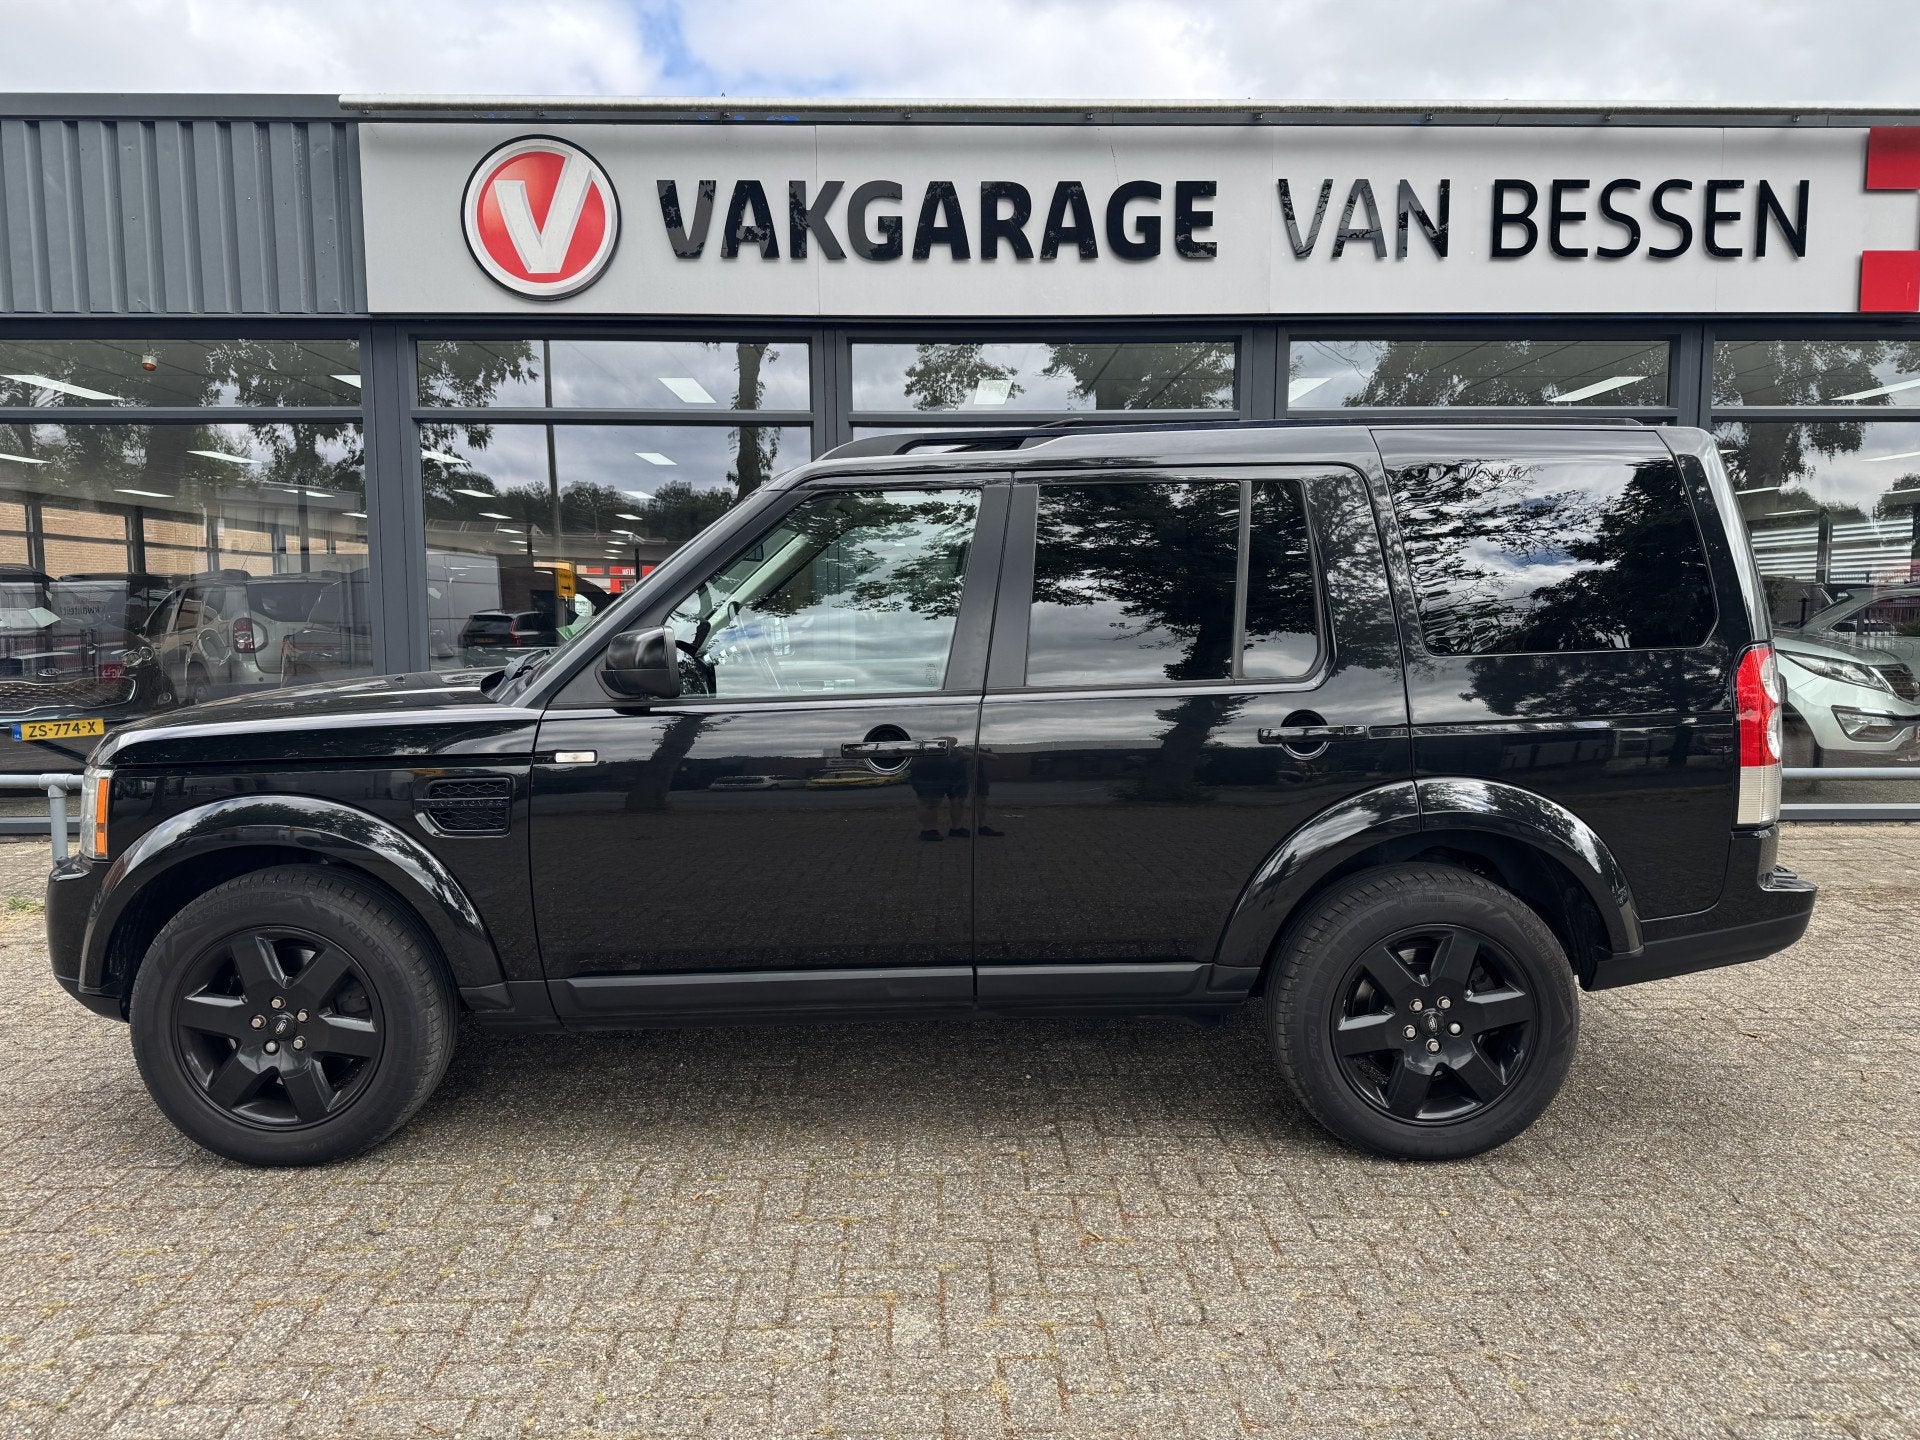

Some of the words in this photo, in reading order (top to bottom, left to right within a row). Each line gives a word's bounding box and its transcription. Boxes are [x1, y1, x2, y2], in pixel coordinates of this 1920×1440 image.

[656, 180, 1218, 260] VAKGARAGE
[1277, 178, 1450, 259] VAN
[1491, 178, 1810, 259] BESSEN
[28, 721, 96, 738] ZS-774-X
